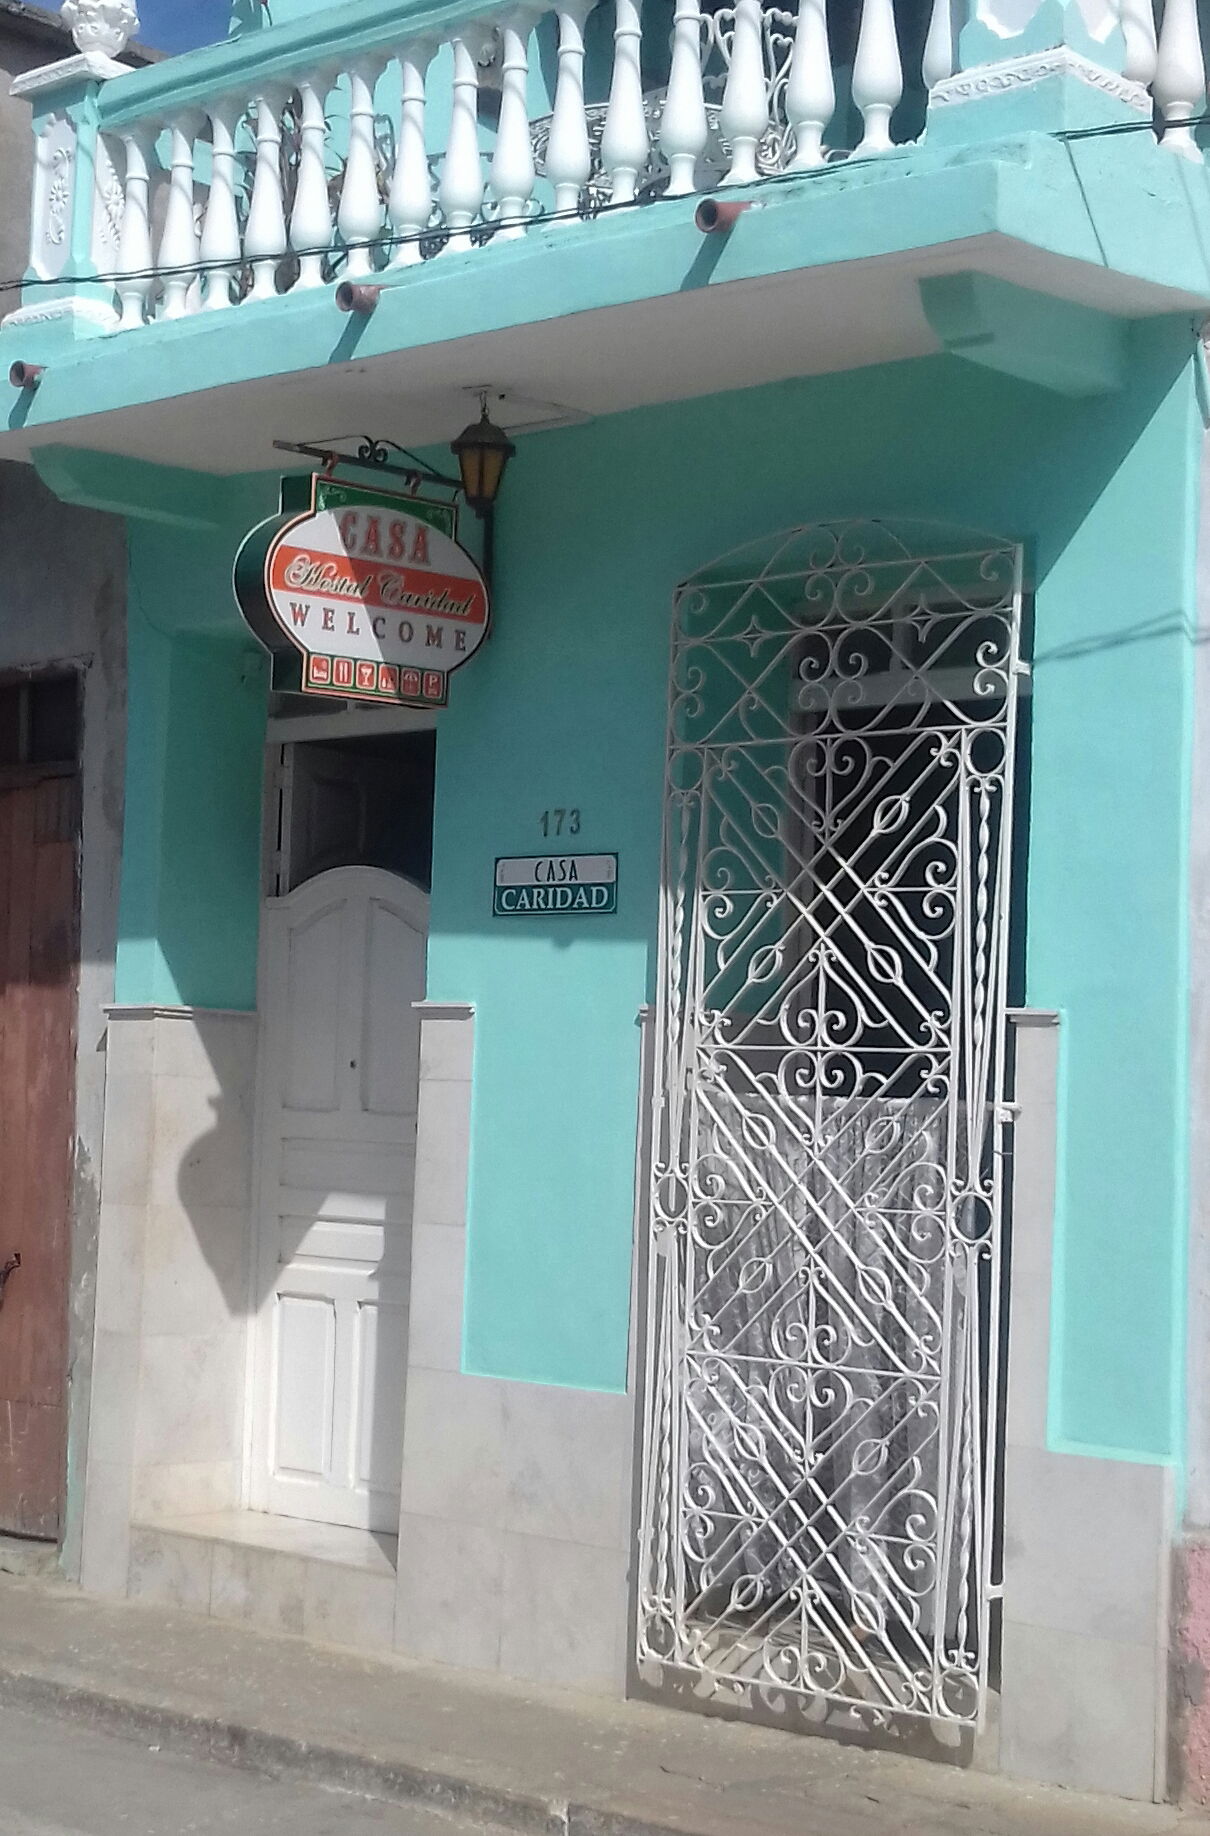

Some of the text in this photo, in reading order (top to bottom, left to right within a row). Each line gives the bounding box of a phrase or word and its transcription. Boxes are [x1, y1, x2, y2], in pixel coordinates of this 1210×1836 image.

[340, 511, 430, 564] CASA
[284, 554, 476, 617] Hostal Caridad
[290, 602, 467, 652] WELCOME
[539, 808, 581, 837] 173
[534, 859, 578, 882] CASA
[501, 886, 608, 910] CARIDAD
